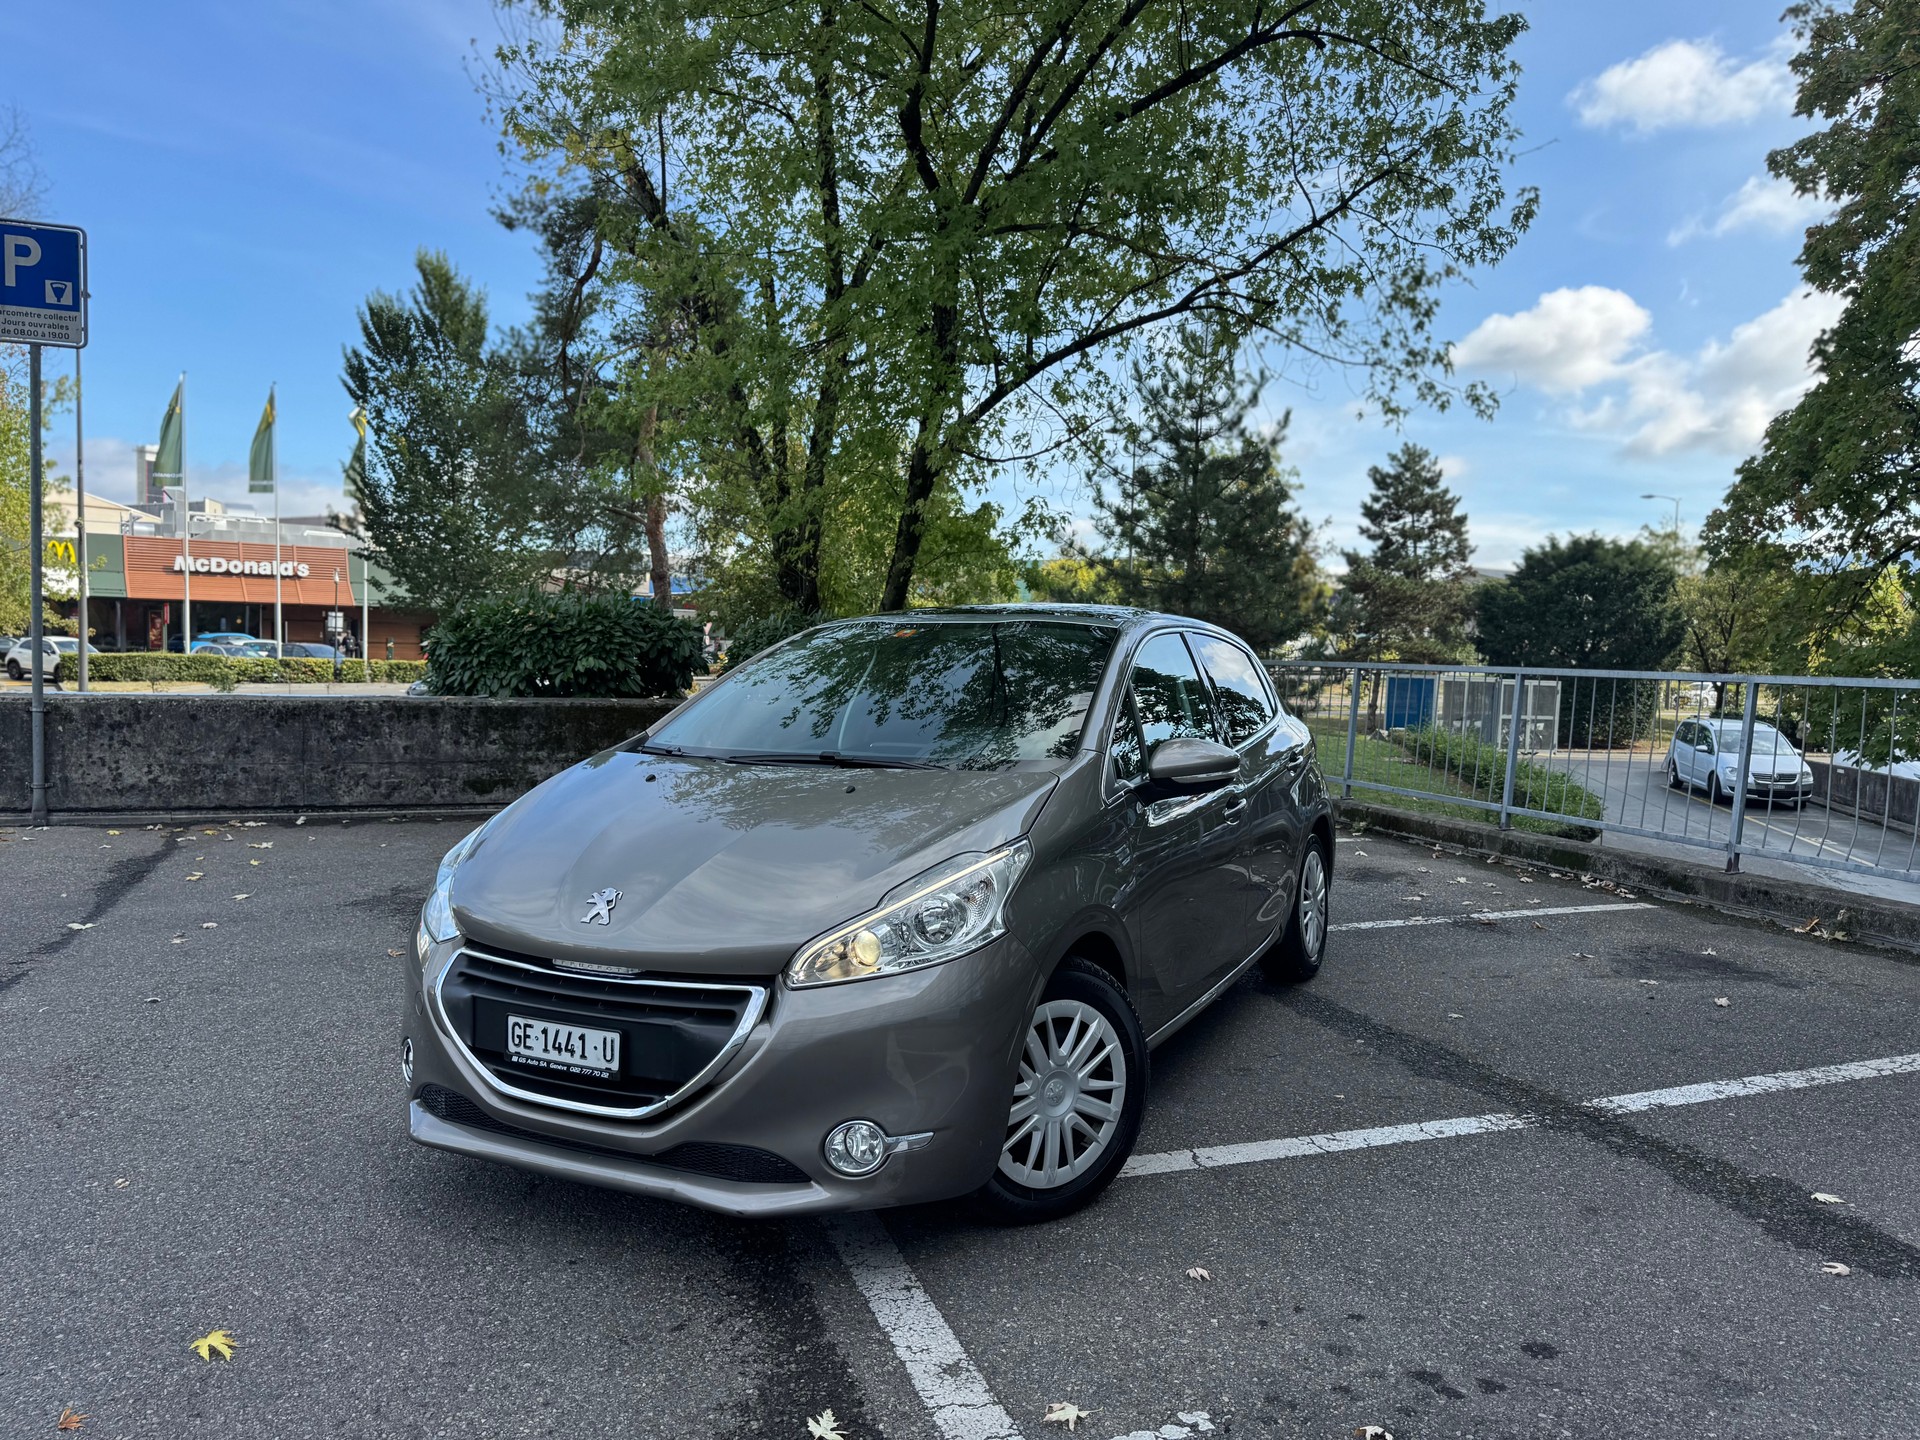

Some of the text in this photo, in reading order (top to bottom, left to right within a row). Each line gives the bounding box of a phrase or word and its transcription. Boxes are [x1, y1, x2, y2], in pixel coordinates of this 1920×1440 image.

[4, 234, 42, 287] P
[1, 318, 70, 331] Jours ouvrables
[44, 313, 78, 322] collectif
[173, 555, 310, 577] McDonald's
[512, 1021, 615, 1064] GE 1441 U
[527, 1058, 539, 1066] Auto
